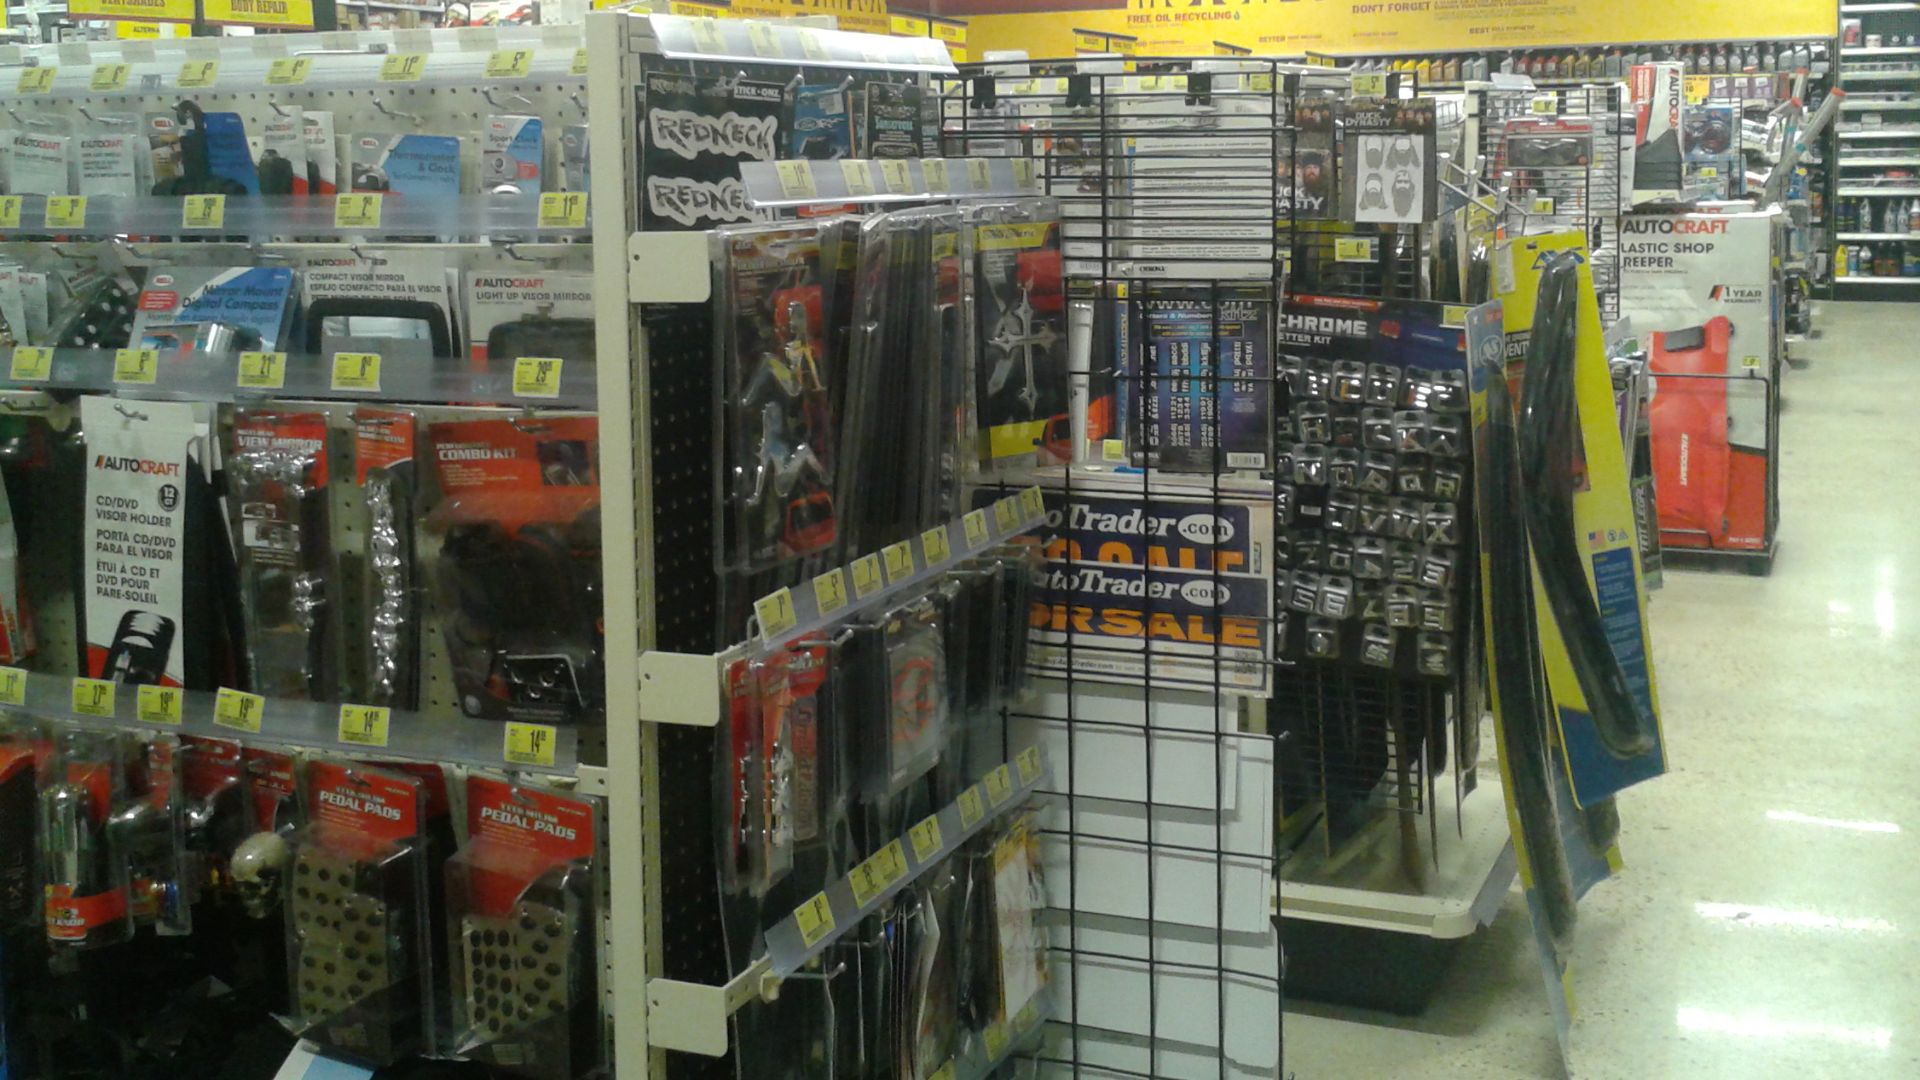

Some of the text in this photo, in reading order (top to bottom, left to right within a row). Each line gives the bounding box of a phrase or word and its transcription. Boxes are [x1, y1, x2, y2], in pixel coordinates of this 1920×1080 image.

[1352, 4, 1384, 15] DON'T
[1387, 2, 1431, 13] FORGET
[1127, 11, 1232, 24] FREE OIL RECYCLING
[1345, 117, 1392, 127] DYNASTY
[653, 112, 774, 158] REDNECK
[1622, 219, 1729, 234] AUTOCRAFT
[1621, 243, 1714, 254] LASTIC SHOP
[1623, 256, 1673, 268] REEPER
[309, 273, 405, 282] COMPACT VISOR MIRROR
[483, 278, 545, 288] AUTOCRAFT
[339, 283, 385, 293] COMPACTO
[1725, 287, 1763, 298] 1 YEAR
[476, 291, 592, 302] LIGHT UP VISOR MIRROR
[1279, 313, 1368, 336] CHROME
[1279, 332, 1332, 345] ETTER KIT
[237, 434, 323, 451] VIEW MIRROR
[438, 447, 517, 461] COMBO KIT
[104, 455, 180, 477] AUTOCRAFT
[163, 486, 175, 498] 12
[96, 495, 139, 510] CD/DVD
[95, 508, 172, 528] VISOR HOLDER
[96, 528, 177, 549] PORTA CD/DVD
[96, 541, 173, 561] PARA EL VISOR
[130, 565, 147, 577] CD
[149, 567, 160, 579] ET
[96, 573, 150, 591] DVD POUR
[96, 586, 159, 605] PARE-SOLEIL
[1098, 607, 1262, 648] SALE
[320, 790, 362, 812] PEDAL
[365, 802, 402, 821] PADS
[481, 806, 530, 829] PEDAL
[534, 820, 577, 841] PADS
